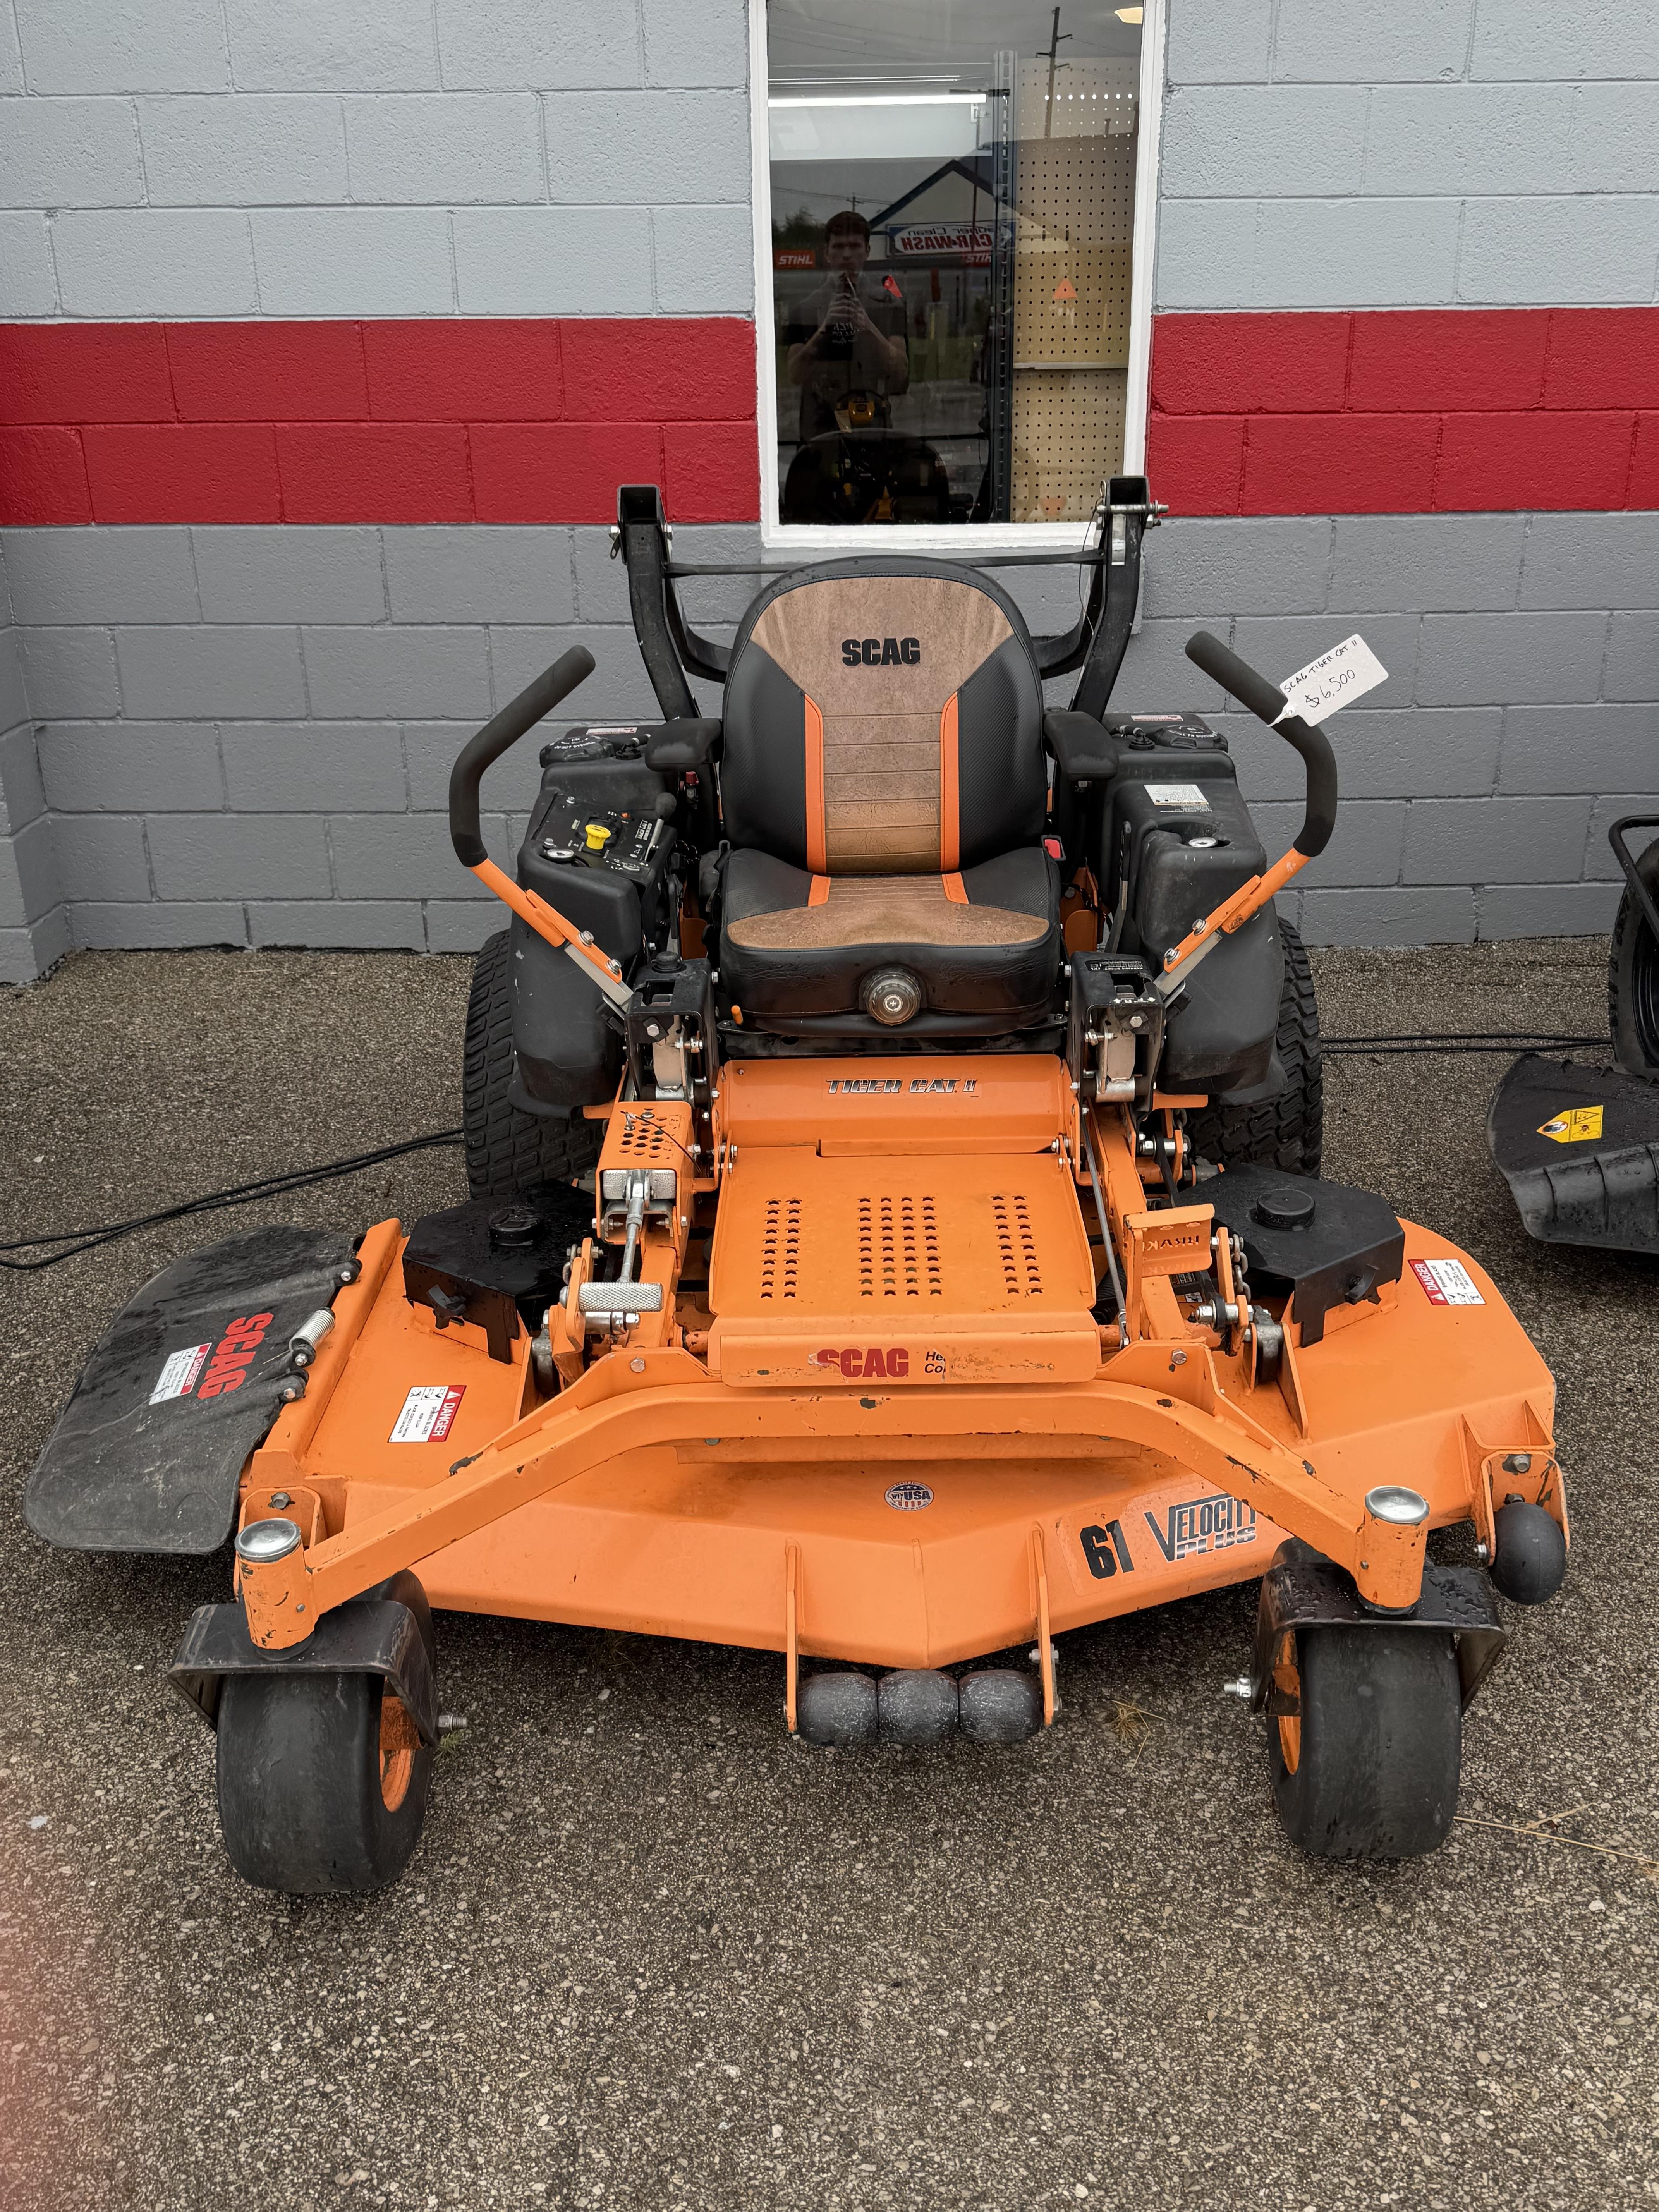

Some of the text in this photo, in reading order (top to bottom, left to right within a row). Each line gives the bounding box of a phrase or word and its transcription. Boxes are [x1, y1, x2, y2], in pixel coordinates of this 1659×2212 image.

[778, 255, 812, 265] STIHL
[966, 253, 991, 263] STIH
[842, 637, 920, 666] SCAG
[1284, 674, 1307, 693] SCAG
[1309, 656, 1333, 674] TIGER
[1335, 645, 1348, 656] CAT
[826, 1078, 978, 1094] TIGER CAT II
[1414, 1263, 1439, 1291] DANGER
[197, 1312, 274, 1400] SCAG
[184, 1358, 203, 1386] DANGER
[431, 1403, 456, 1436] DANGER
[904, 1491, 931, 1500] USA
[1080, 1519, 1135, 1579] 61
[1176, 1526, 1256, 1560] PLUS
